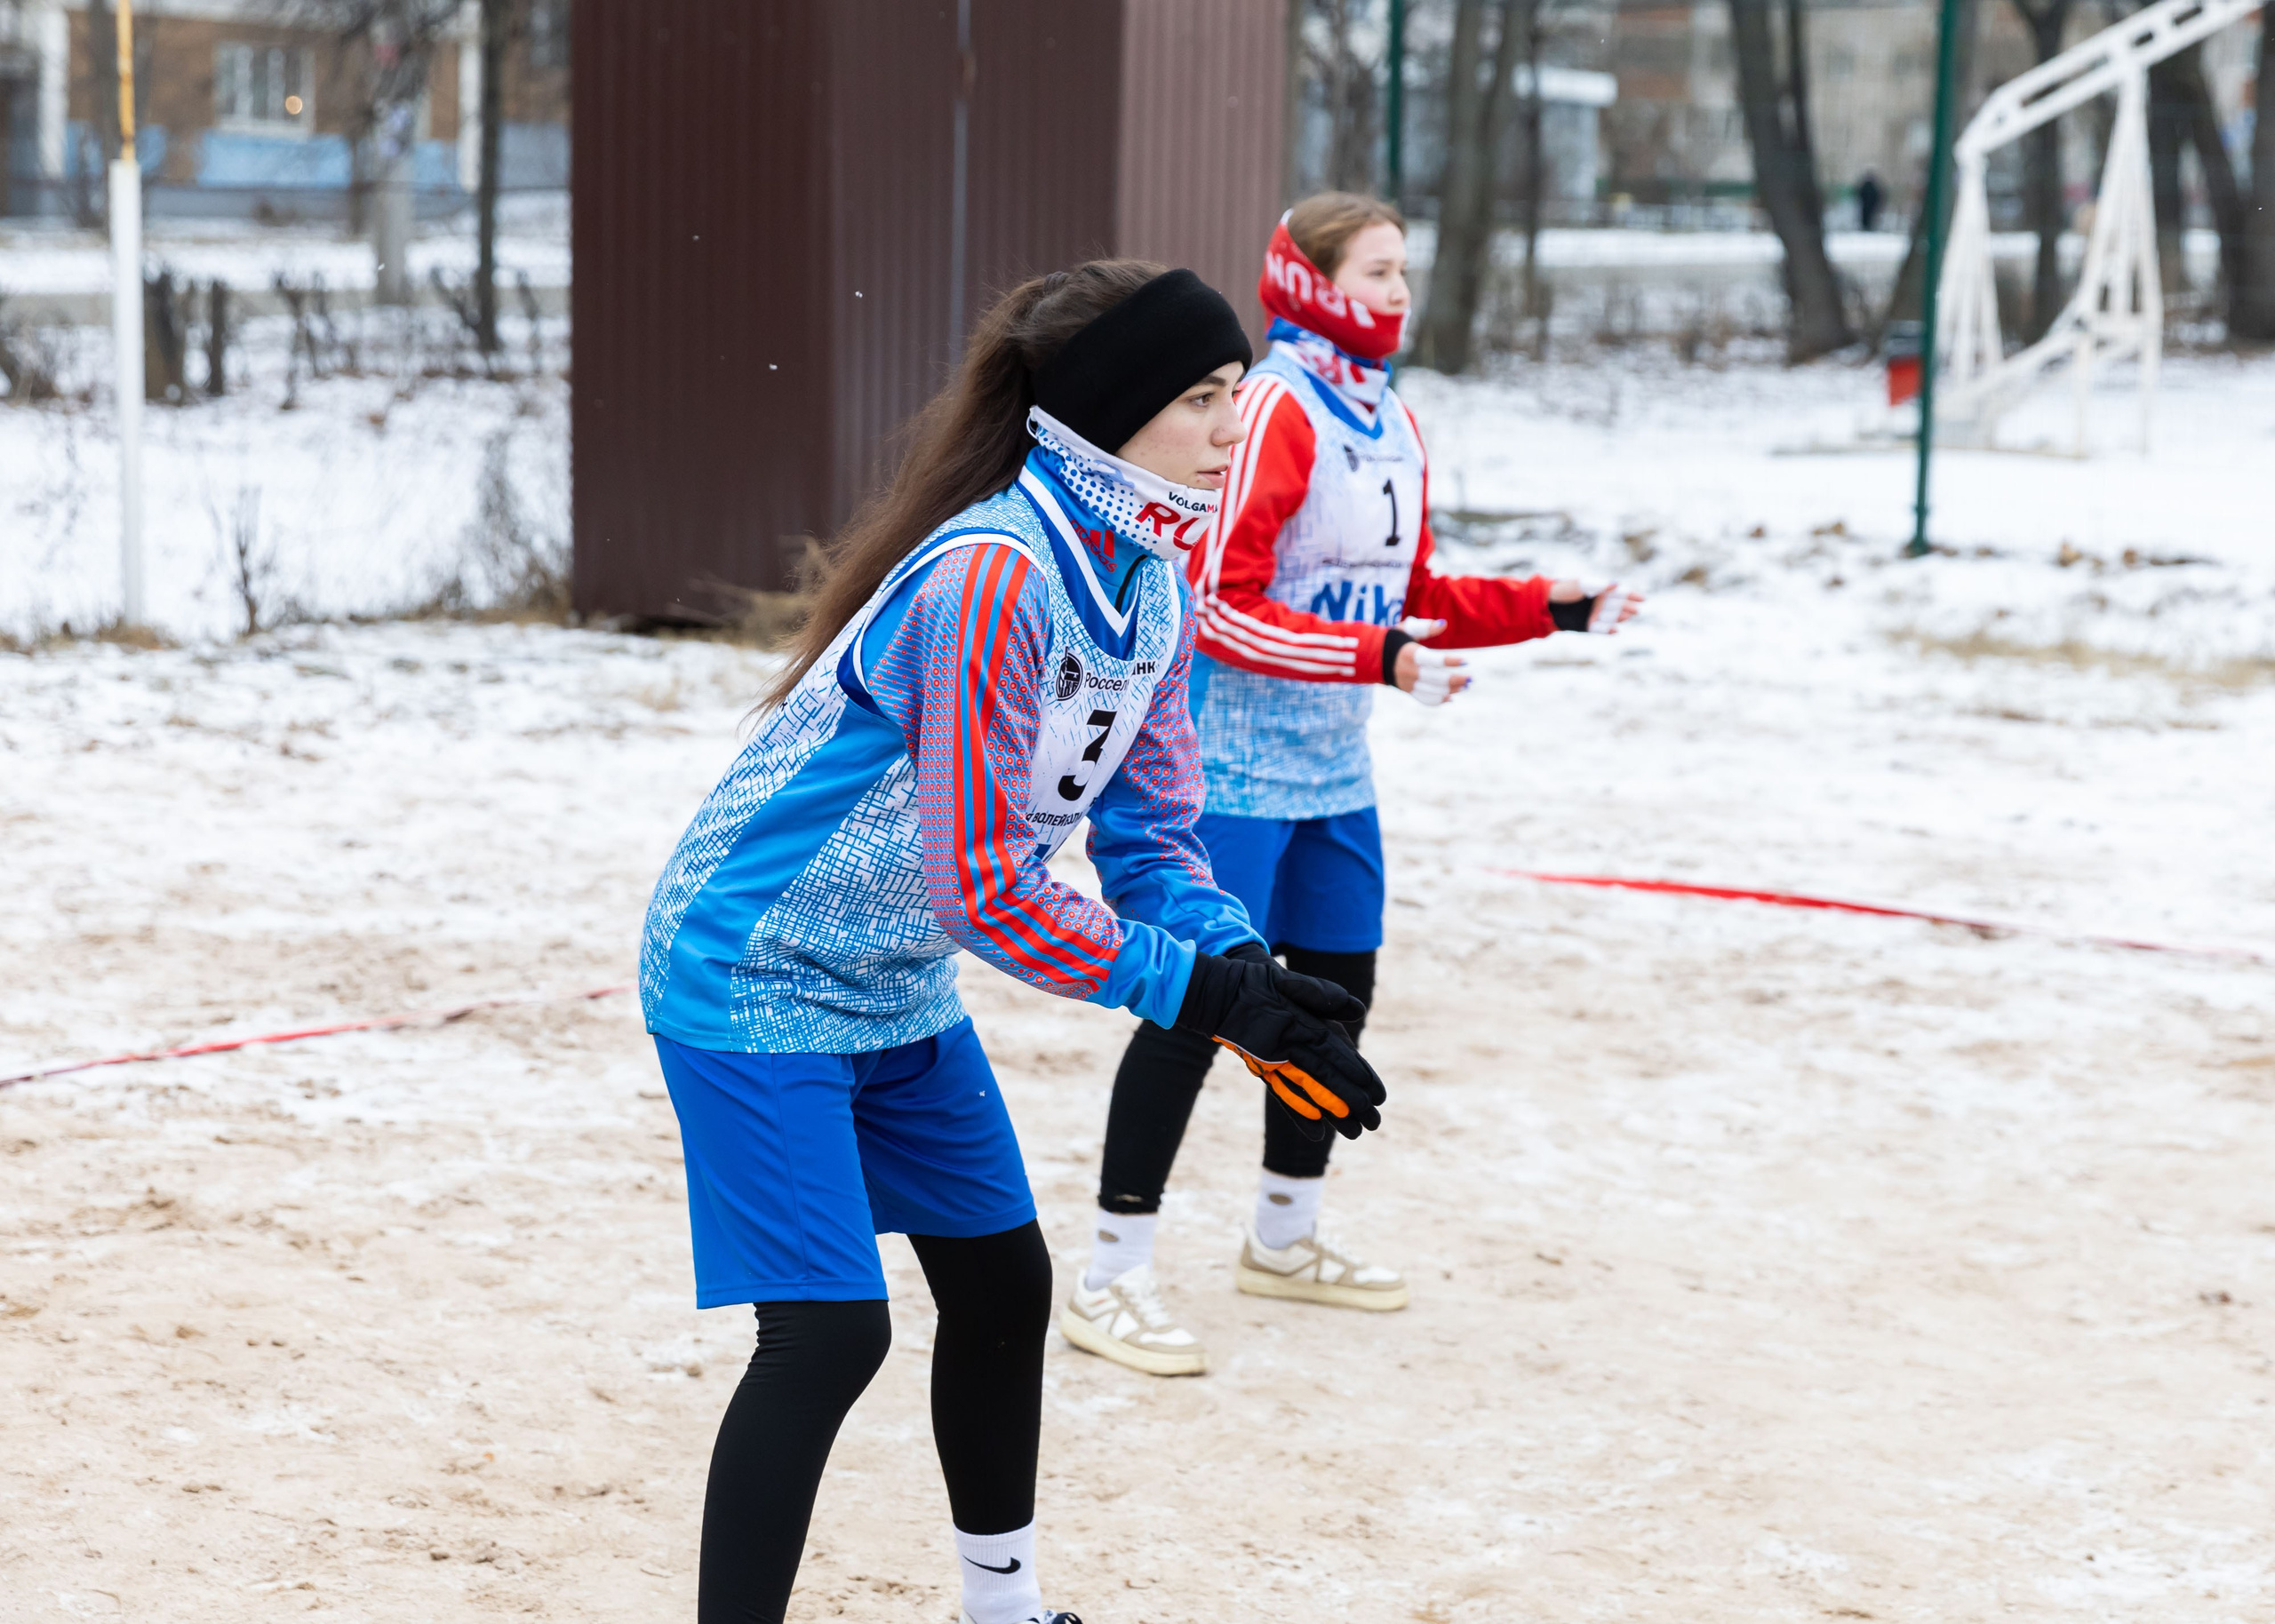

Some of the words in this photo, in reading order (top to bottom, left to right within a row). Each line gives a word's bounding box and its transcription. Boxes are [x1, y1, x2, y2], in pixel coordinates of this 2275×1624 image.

[1070, 519, 1118, 573] adidas
[1382, 478, 1401, 547] 1
[1058, 708, 1118, 801] 3
